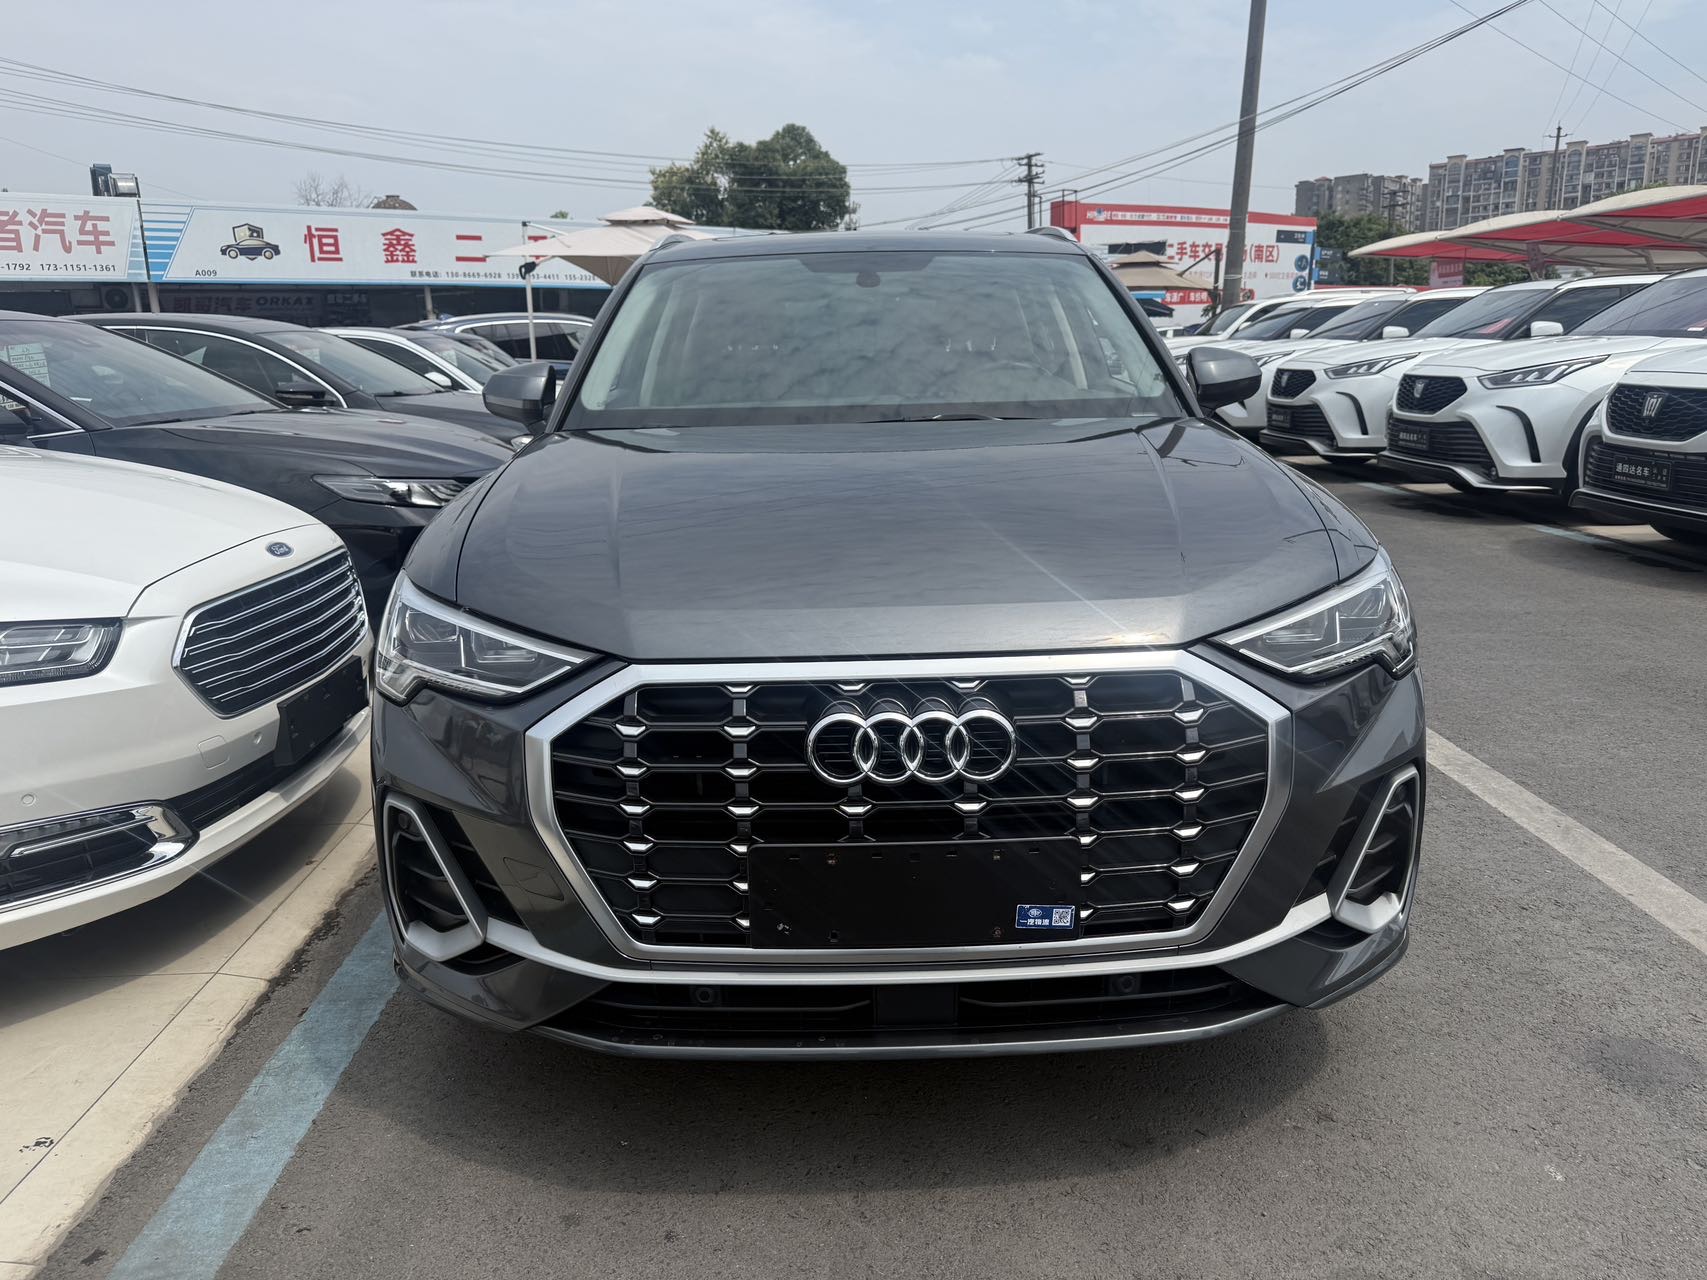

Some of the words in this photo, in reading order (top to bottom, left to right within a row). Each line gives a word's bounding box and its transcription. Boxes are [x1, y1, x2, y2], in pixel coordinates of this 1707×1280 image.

[303, 224, 548, 265] 恒鑫二
[40, 263, 116, 272] 173-1151-1361
[195, 269, 217, 277] A009
